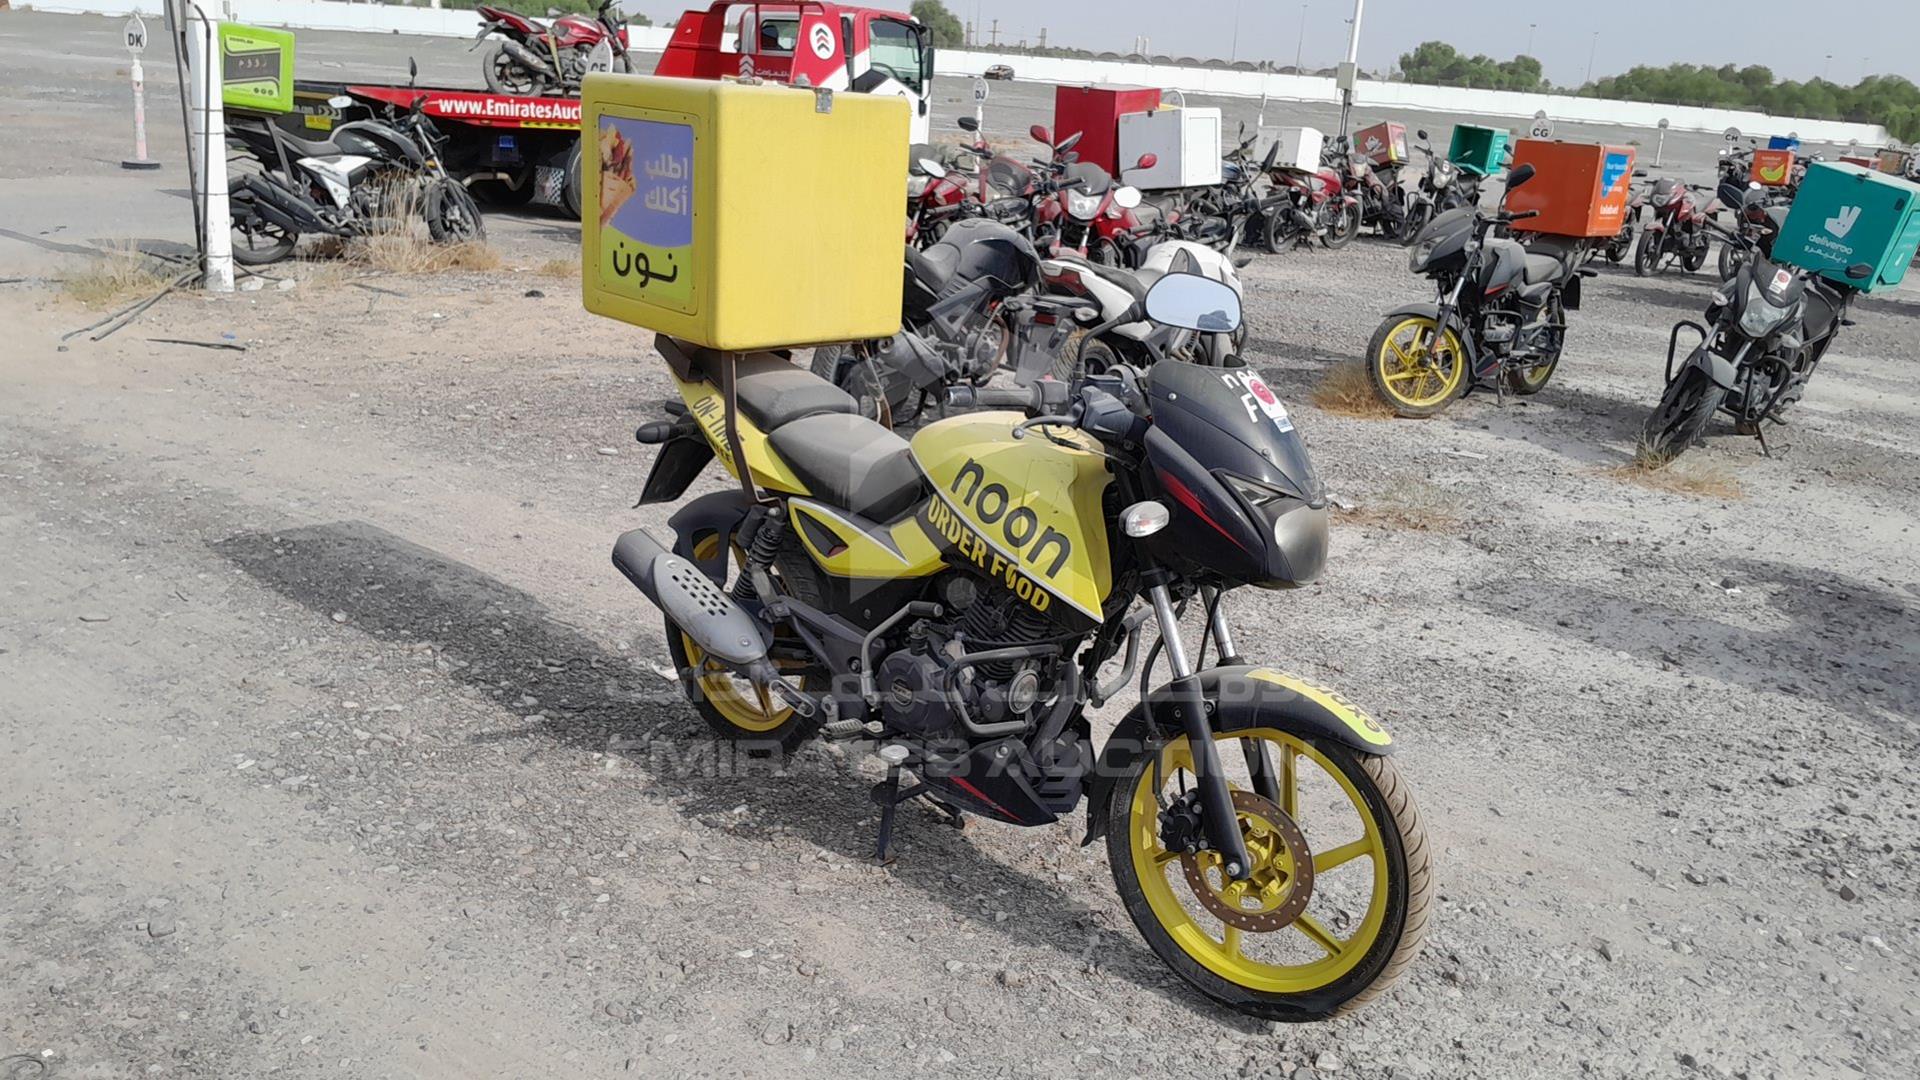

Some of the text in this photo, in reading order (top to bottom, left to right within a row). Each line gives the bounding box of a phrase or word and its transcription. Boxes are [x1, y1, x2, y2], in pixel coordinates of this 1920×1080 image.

[128, 33, 143, 47] DK
[1532, 127, 1549, 138] CG
[1725, 133, 1739, 142] CH
[644, 153, 689, 181] اطلب
[644, 184, 688, 216] أكلك
[1808, 233, 1854, 255] deliveroo
[612, 241, 678, 288] نون
[950, 457, 1072, 580] noon
[927, 493, 1051, 613] ORDER FOOD
